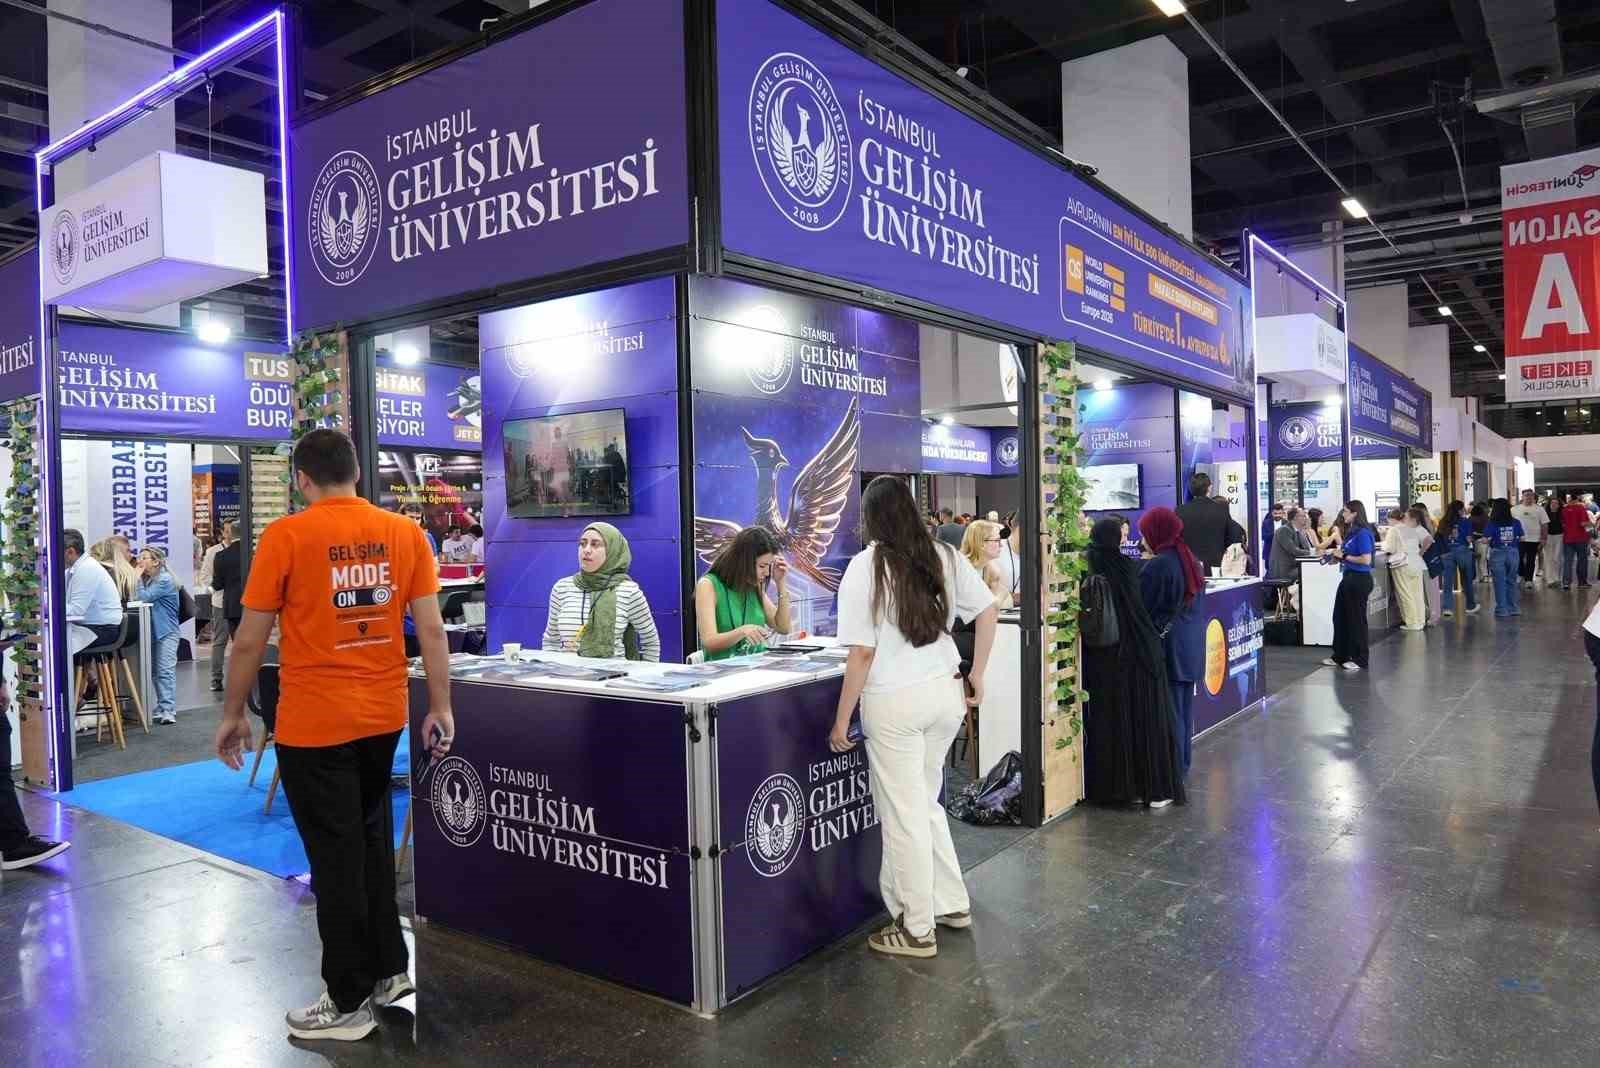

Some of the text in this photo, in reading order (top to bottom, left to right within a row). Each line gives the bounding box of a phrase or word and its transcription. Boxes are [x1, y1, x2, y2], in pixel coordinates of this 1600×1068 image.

[386, 109, 477, 162] İSTANBUL
[858, 89, 941, 158] İSTANBUL
[388, 123, 545, 212] GELİŞİM
[859, 138, 986, 228] GELİŞİM
[388, 137, 660, 263] ÜNİVERSİTESİ
[793, 207, 819, 224] 2008
[83, 210, 125, 242] GELİŞİM
[84, 217, 150, 263] ÜNİVERSİTESİ
[859, 186, 1039, 294] ÜNİVERSİTESİ
[800, 322, 836, 344] İSTANBUL
[0, 335, 34, 375] İTESİ
[60, 350, 116, 367] TANBUL
[249, 357, 290, 377] TUS
[800, 344, 858, 372] GELİŞİM
[249, 382, 291, 405] ÖDÜ
[376, 368, 424, 394] BİTAK
[801, 363, 887, 396] ÜNİVERSİTESİ
[376, 397, 423, 418] ELER
[331, 561, 391, 590] MODE
[337, 590, 357, 607] ON
[490, 759, 553, 793] İSTANBUL
[490, 789, 597, 836] GELİŞİM
[491, 818, 670, 889] ÜNİVERSİTESİ
